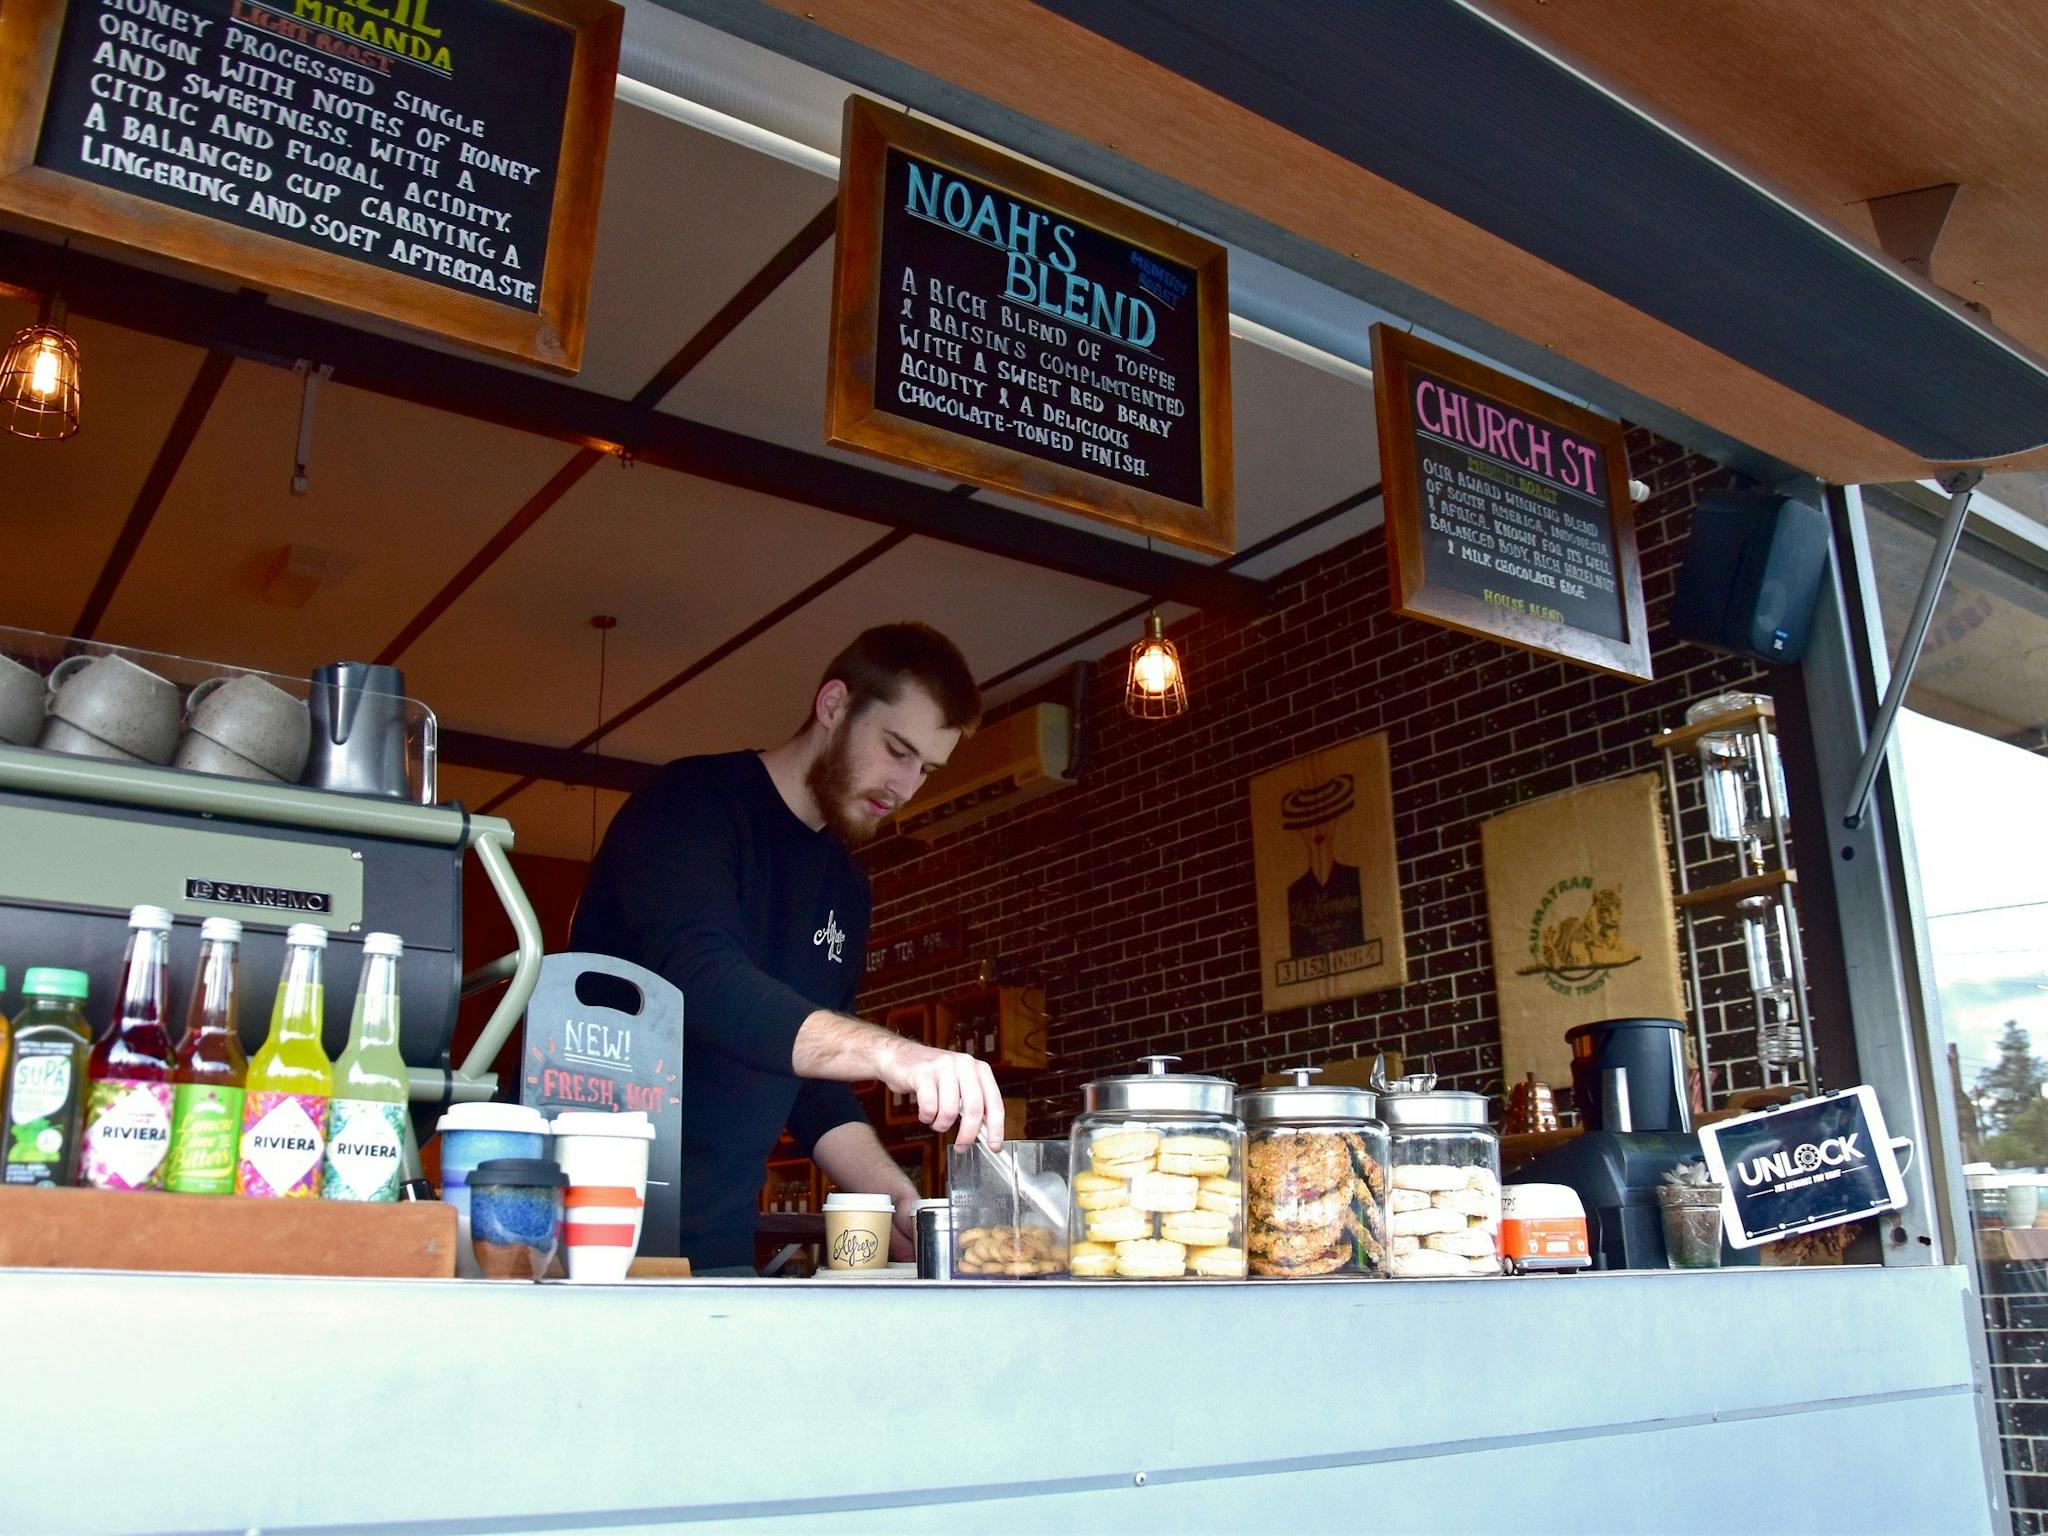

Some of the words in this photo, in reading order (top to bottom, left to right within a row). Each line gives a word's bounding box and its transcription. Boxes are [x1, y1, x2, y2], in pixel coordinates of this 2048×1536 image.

[231, 0, 314, 44] LIGHT
[293, 0, 453, 71] MIRANDA
[92, 41, 166, 82] AND
[370, 137, 441, 179] WITH
[456, 169, 476, 192] A
[99, 13, 202, 66] ORIGIN
[219, 54, 296, 100] WITH
[311, 88, 404, 138] NOTES
[416, 127, 450, 153] OF
[459, 142, 541, 185] HONEY
[224, 27, 375, 96] PROCESSED
[393, 90, 486, 139] SINGLE
[84, 102, 107, 132] A
[122, 115, 273, 182] BALANCED
[286, 173, 341, 204] CUP
[361, 196, 496, 259] CARRYING
[501, 244, 521, 270] A
[91, 73, 199, 126] CITRIC
[210, 113, 274, 150] AND
[286, 139, 384, 191] FLORAL
[404, 181, 512, 234] ACIDITY.
[81, 134, 240, 206] LINGERING
[246, 191, 308, 229] AND
[310, 213, 381, 252] SOFT
[904, 161, 1078, 274] NOAH'S
[902, 266, 918, 295] A
[930, 277, 988, 320] RICH
[1001, 305, 1068, 347] BLEND
[1078, 338, 1101, 362] OF
[1115, 353, 1176, 392] TOFFEE
[929, 306, 1027, 360] RAISINS
[1003, 250, 1157, 349] BLEND
[898, 380, 1074, 452] CHOCOLATE-TONED
[899, 323, 963, 365] WITH
[974, 352, 987, 374] A
[997, 360, 1062, 398] SWEET
[1070, 385, 1105, 413] RED
[1117, 404, 1173, 439] BERRY
[900, 352, 989, 399] ACIDITY
[1019, 395, 1034, 418] A
[1043, 403, 1130, 450] DELICIOUS
[1416, 379, 1554, 479] CHURCH
[1560, 437, 1597, 496] ST
[1423, 458, 1455, 483] OUR
[1458, 471, 1501, 501] AWARD
[1563, 512, 1598, 538] BLEND
[1426, 478, 1443, 495] OF
[1447, 485, 1486, 512] SOUTH
[1429, 513, 1495, 550] BALANCED
[1533, 550, 1562, 574] RICH
[1564, 561, 1616, 594] HAZELNUT
[1461, 544, 1493, 568] MILK
[1495, 557, 1557, 590] CHOCOLATE
[1494, 519, 1537, 547] KNOWN
[1541, 537, 1564, 557] FOR
[1585, 554, 1612, 576] WELL
[1483, 588, 1525, 613] HOUSE
[1529, 602, 1565, 625] BLEND
[217, 884, 323, 911] SANREMO
[564, 1019, 631, 1061] NEW!
[102, 1126, 168, 1141] RIVIERA
[254, 1136, 316, 1151] RIVIERA
[337, 1143, 397, 1158] RIVIERA
[1737, 1132, 1866, 1187] UNLOCK
